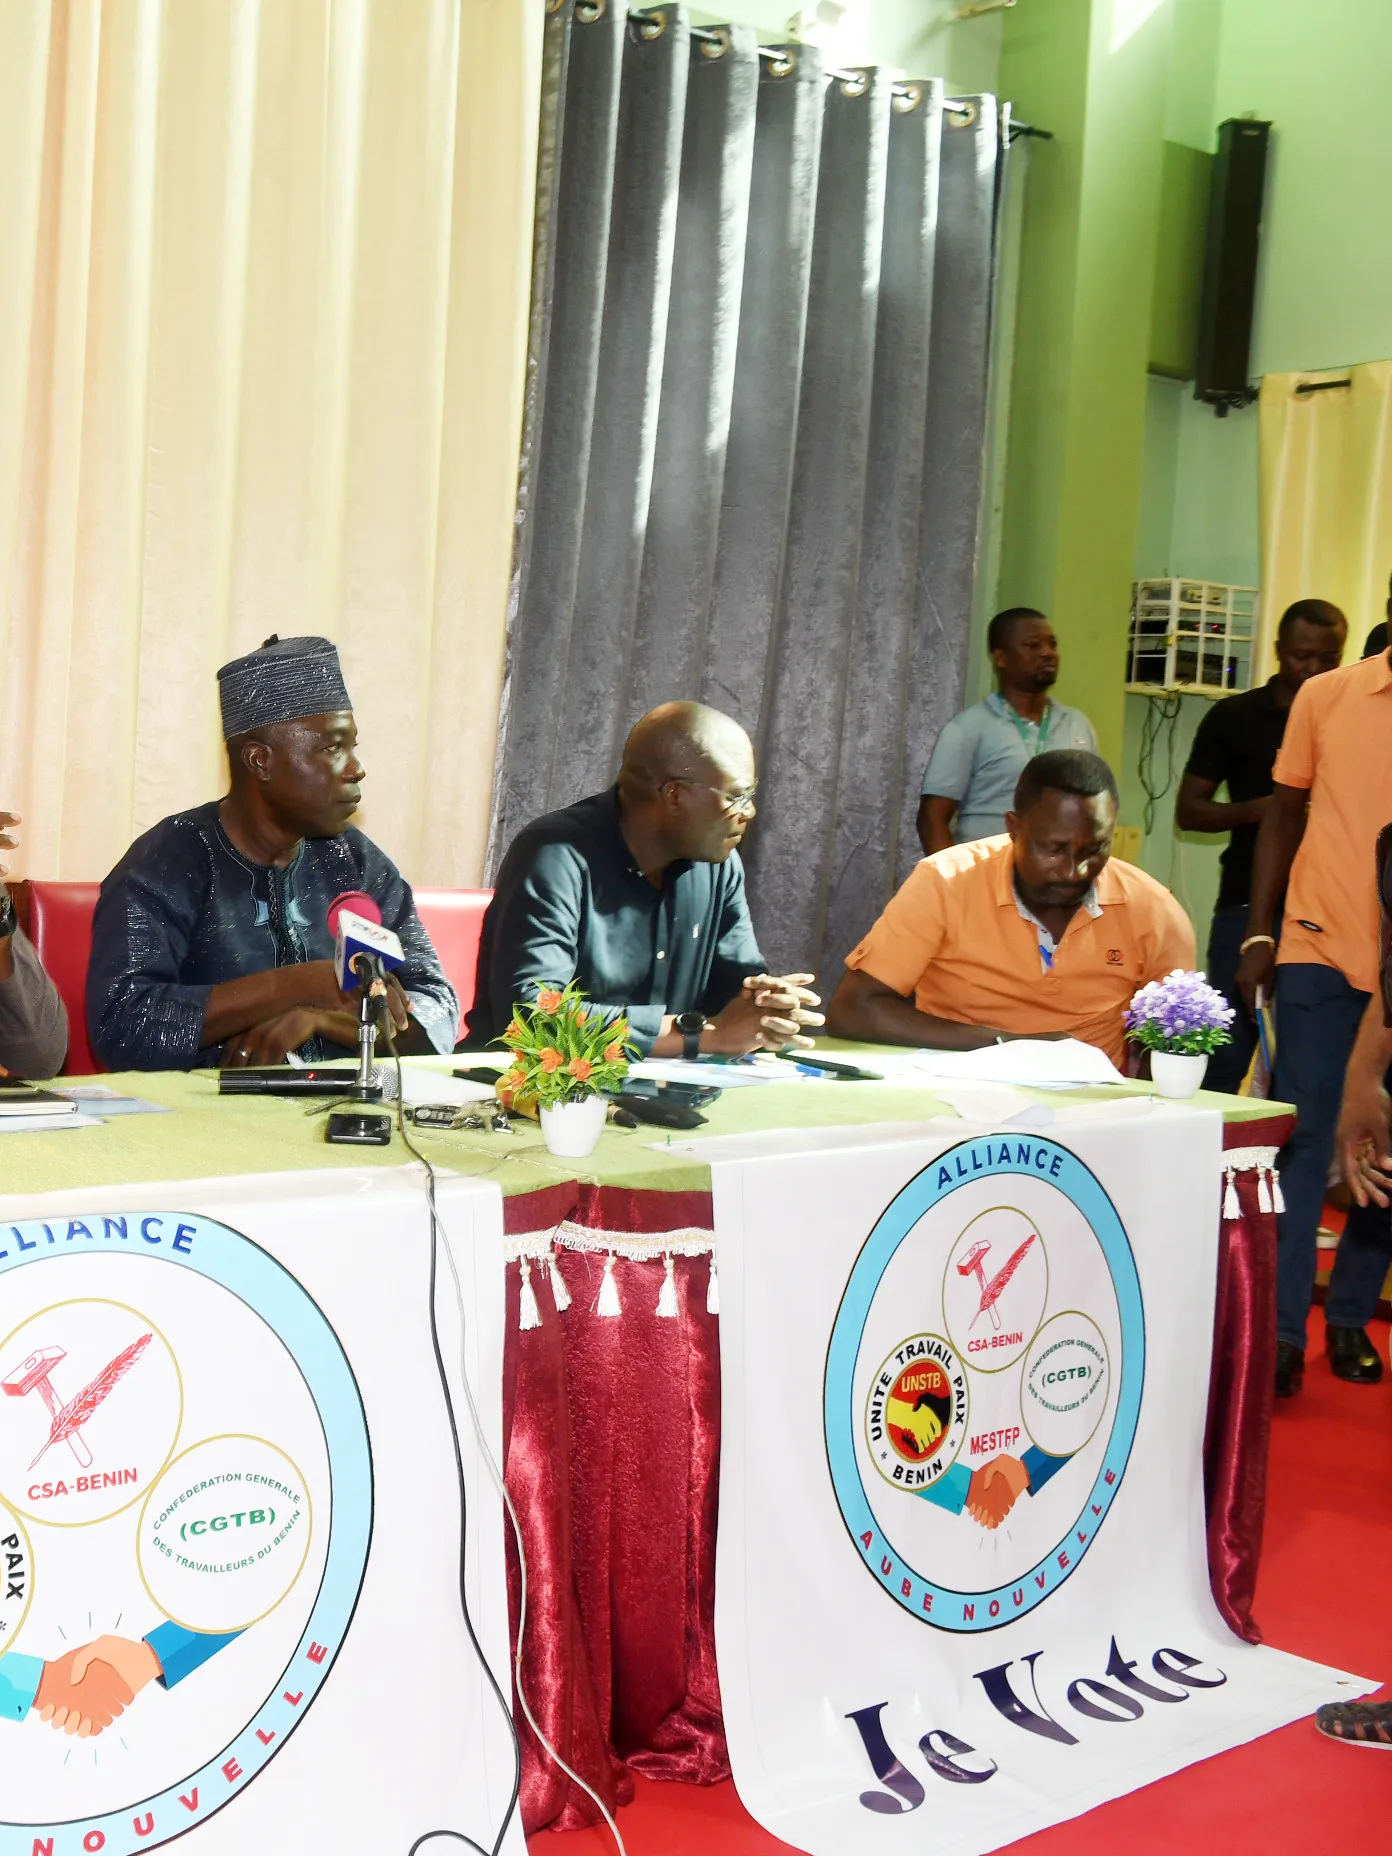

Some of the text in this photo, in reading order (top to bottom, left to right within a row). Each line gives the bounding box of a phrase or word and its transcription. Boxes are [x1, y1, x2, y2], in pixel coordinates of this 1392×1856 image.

[937, 1142, 1065, 1190] ALLIANCE
[967, 1332, 1023, 1353] CSA-BENIN
[1029, 1338, 1105, 1378] CONFEDERATION GENERALE
[871, 1340, 965, 1441] UNITE TRAVAIL PAIX
[901, 1371, 942, 1394] UNSTB
[1041, 1366, 1092, 1388] (CGTB)
[1038, 1396, 1081, 1412] TRAVAILLEURS
[969, 1426, 1021, 1456] MESTFP
[27, 1467, 138, 1502] CSA-BENIN
[893, 1458, 944, 1485] BENIN
[153, 1473, 301, 1531] CONFEDERATION GENERALE
[152, 1510, 301, 1573] DES TRAVAILLEURS DU BENIN
[179, 1507, 276, 1541] (CGTB)
[859, 1469, 1116, 1622] AUBE NOUVELLE
[0, 1533, 25, 1600] PAIX
[844, 1634, 1228, 1815] Je Vote
[31, 1641, 328, 1856] NOUVELLE
